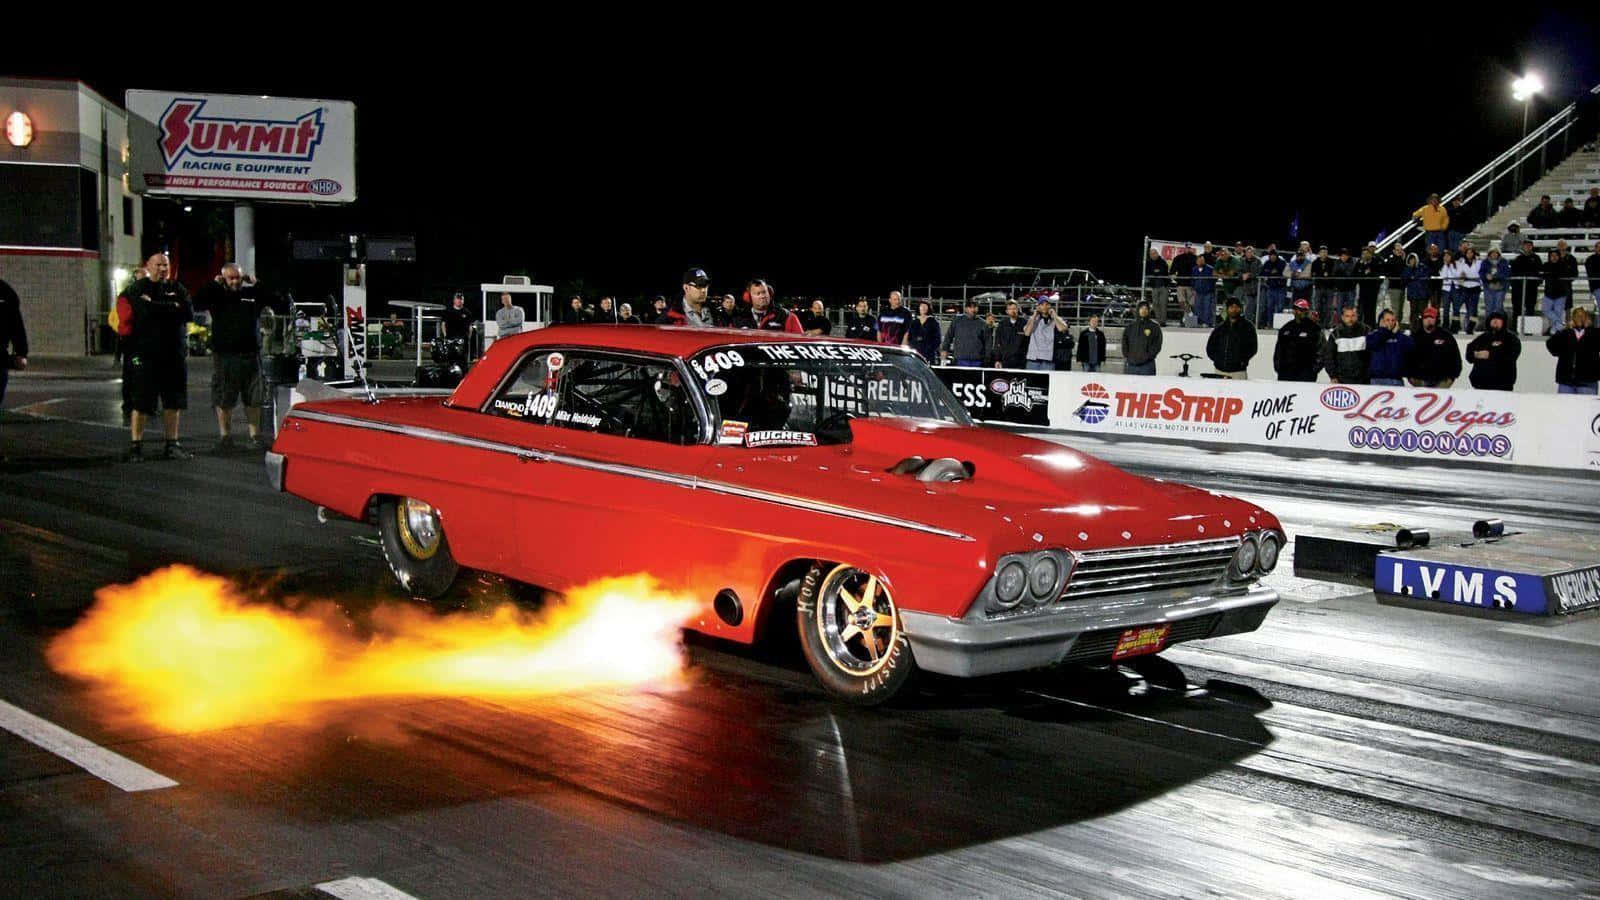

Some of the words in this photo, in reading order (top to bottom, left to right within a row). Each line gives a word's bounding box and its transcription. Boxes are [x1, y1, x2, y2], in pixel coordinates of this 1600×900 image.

[182, 160, 232, 171] RACING
[235, 163, 311, 175] EQUIPMENT
[172, 176, 195, 186] HIGH
[198, 177, 261, 189] PERFORMANCE
[263, 180, 297, 190] SOURCE
[309, 180, 340, 194] NHRA
[705, 350, 745, 373] 409
[758, 345, 798, 360] THE
[800, 345, 838, 361] RACE
[838, 346, 884, 362] SHOP
[494, 399, 525, 412] DIAMOND
[1251, 393, 1298, 419] HOME
[1323, 388, 1359, 409] NHRA
[1344, 390, 1411, 422] Las
[1413, 392, 1516, 436] Vegas
[748, 430, 813, 441] HUGHES
[1140, 423, 1162, 431] VEGAS
[1165, 424, 1189, 432] MOTOR
[1192, 425, 1229, 434] SPEEDWAY
[1265, 420, 1285, 441] OF
[1288, 414, 1320, 436] THE
[1350, 427, 1510, 456] NATIONALS
